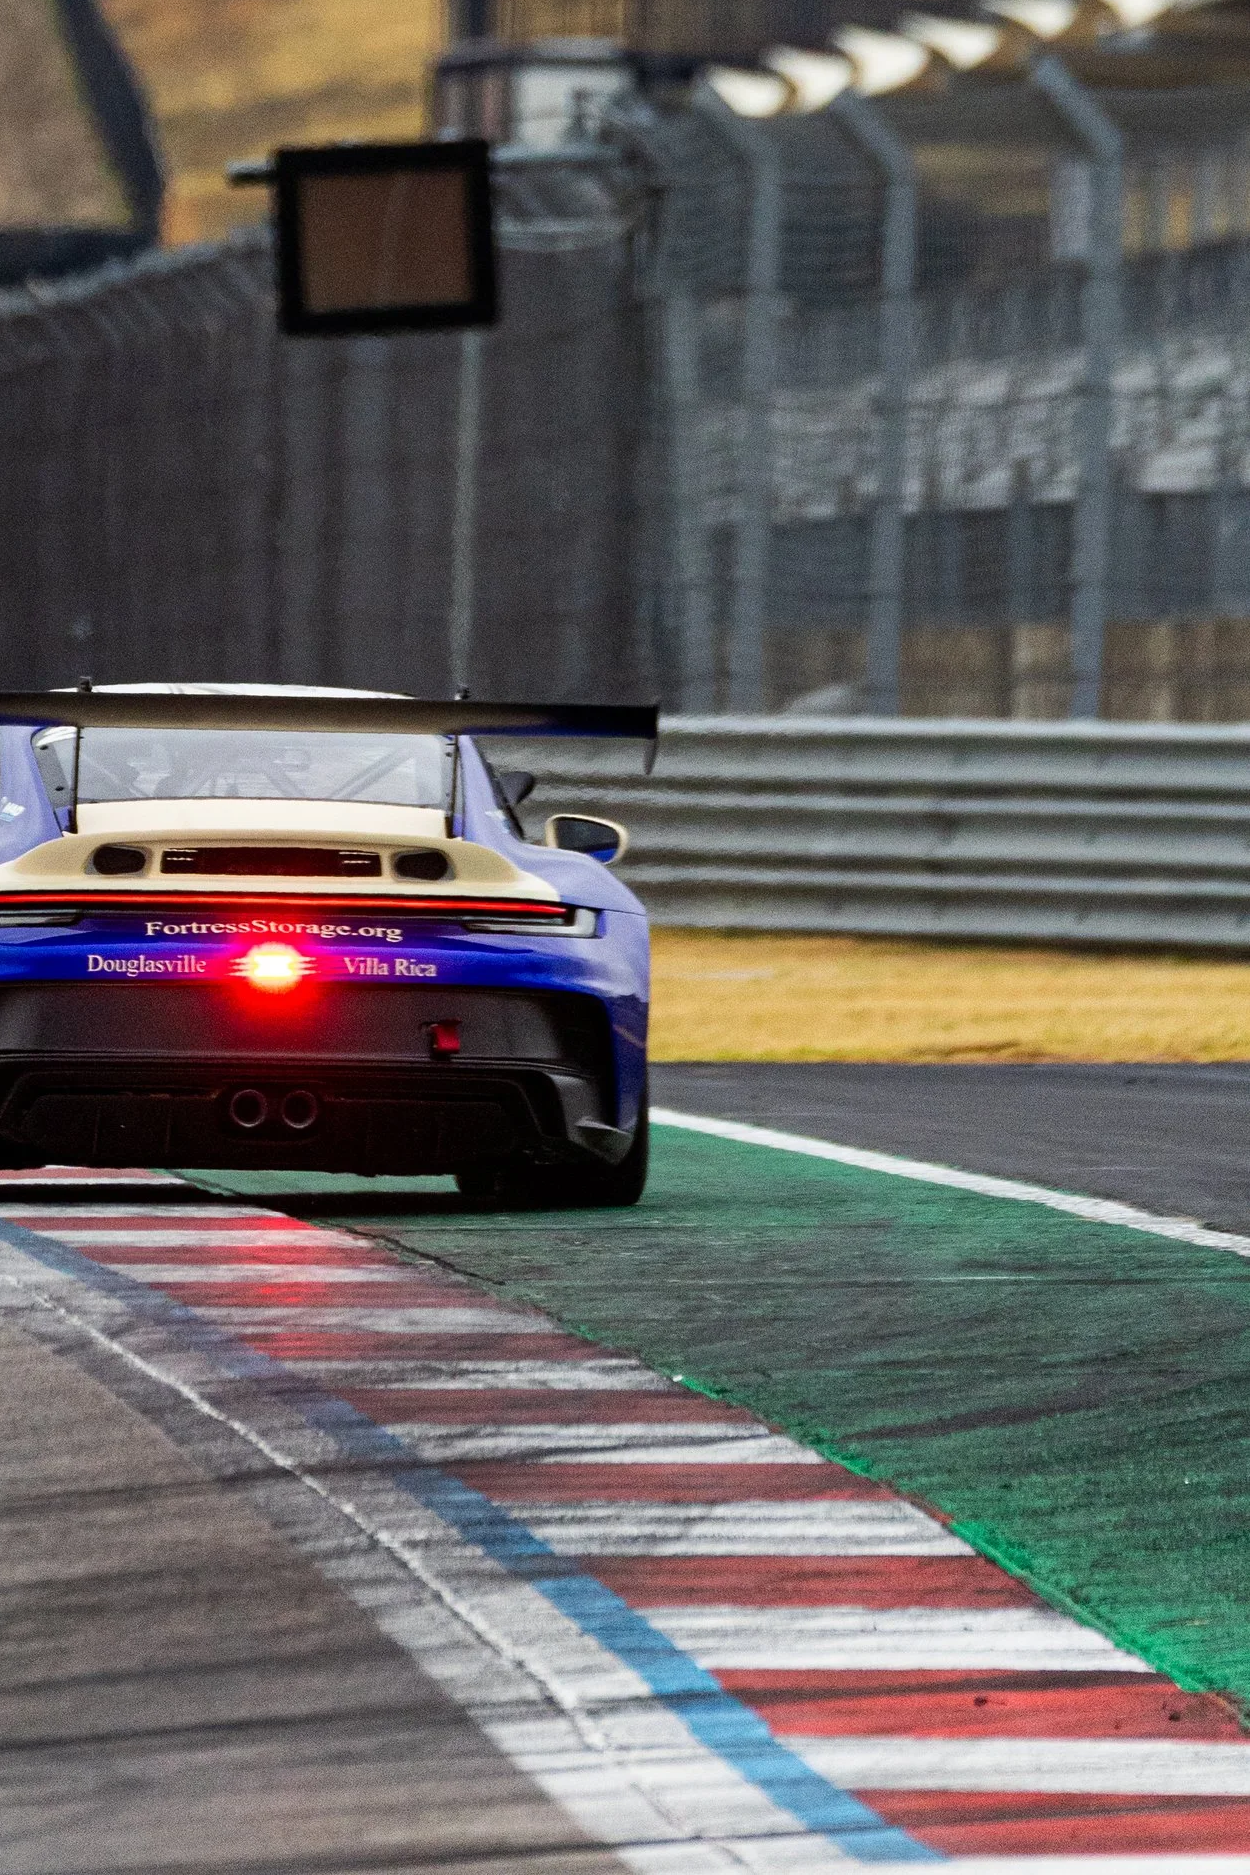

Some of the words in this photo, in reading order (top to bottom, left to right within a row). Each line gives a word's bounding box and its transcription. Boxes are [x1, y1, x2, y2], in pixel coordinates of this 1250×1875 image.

[144, 920, 404, 943] FortressStorage.org
[86, 954, 207, 977] Douglasville
[343, 957, 389, 976] Villa
[394, 958, 438, 977] Rica
